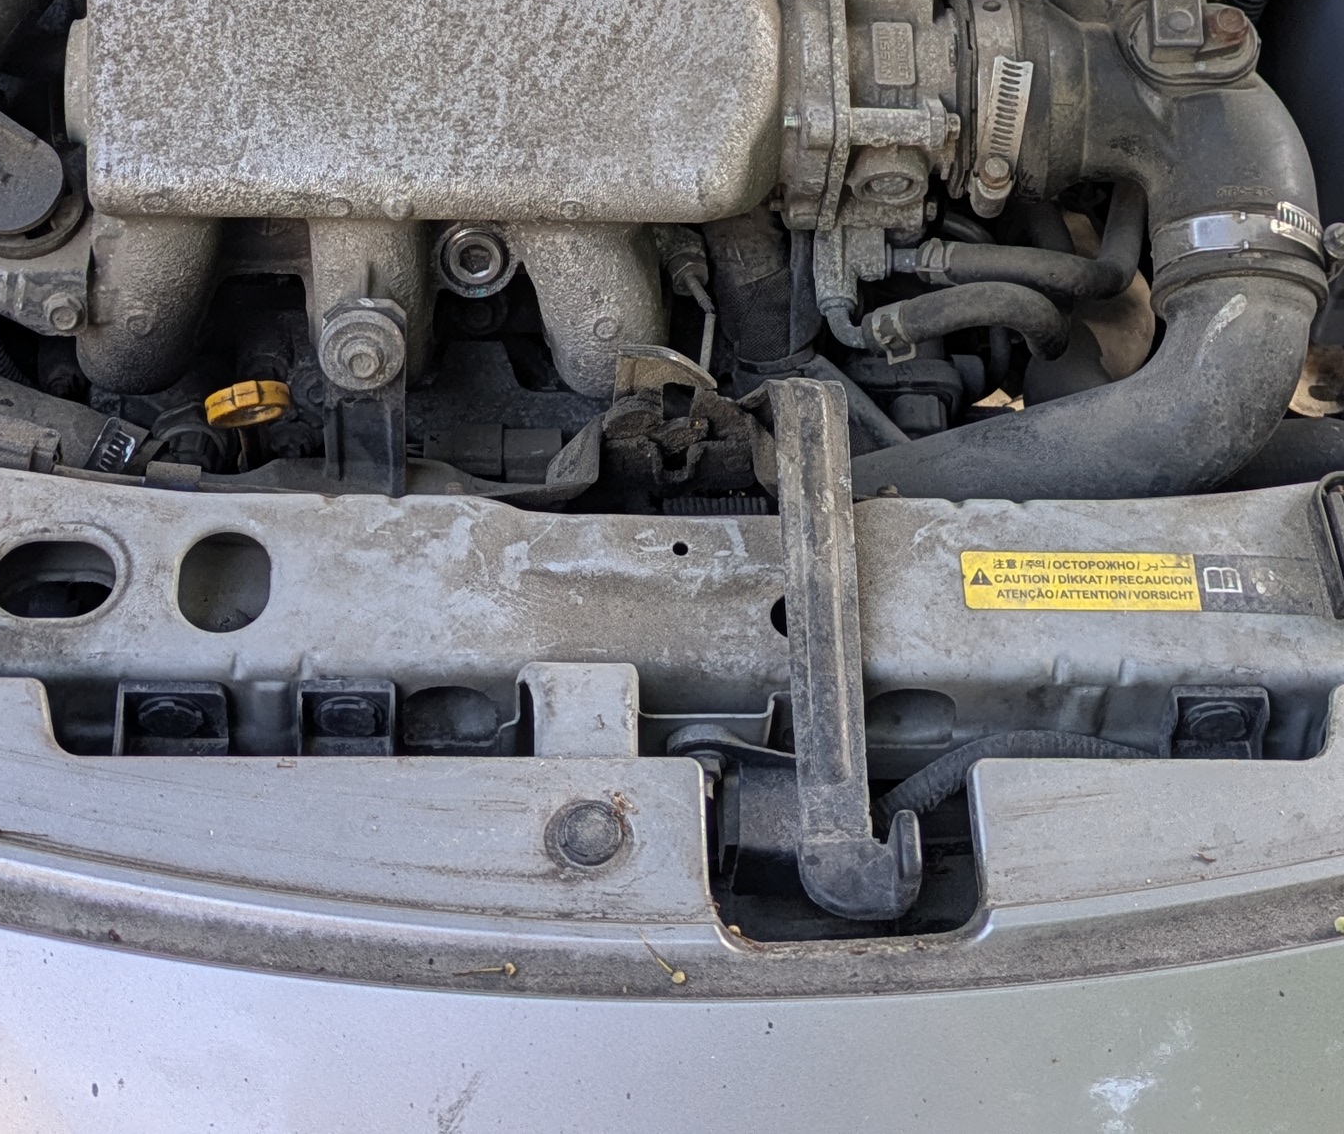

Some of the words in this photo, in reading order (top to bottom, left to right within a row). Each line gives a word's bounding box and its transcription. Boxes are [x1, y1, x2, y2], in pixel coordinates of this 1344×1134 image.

[1052, 560, 1136, 570] ОСТОРОЖНО
[994, 574, 1050, 584] CAUTION
[1110, 575, 1192, 585] PRECAUCION
[997, 588, 1054, 601] ATENÇÃO
[1060, 590, 1127, 600] ATTENTION
[1132, 590, 1194, 600] VORSICHT
